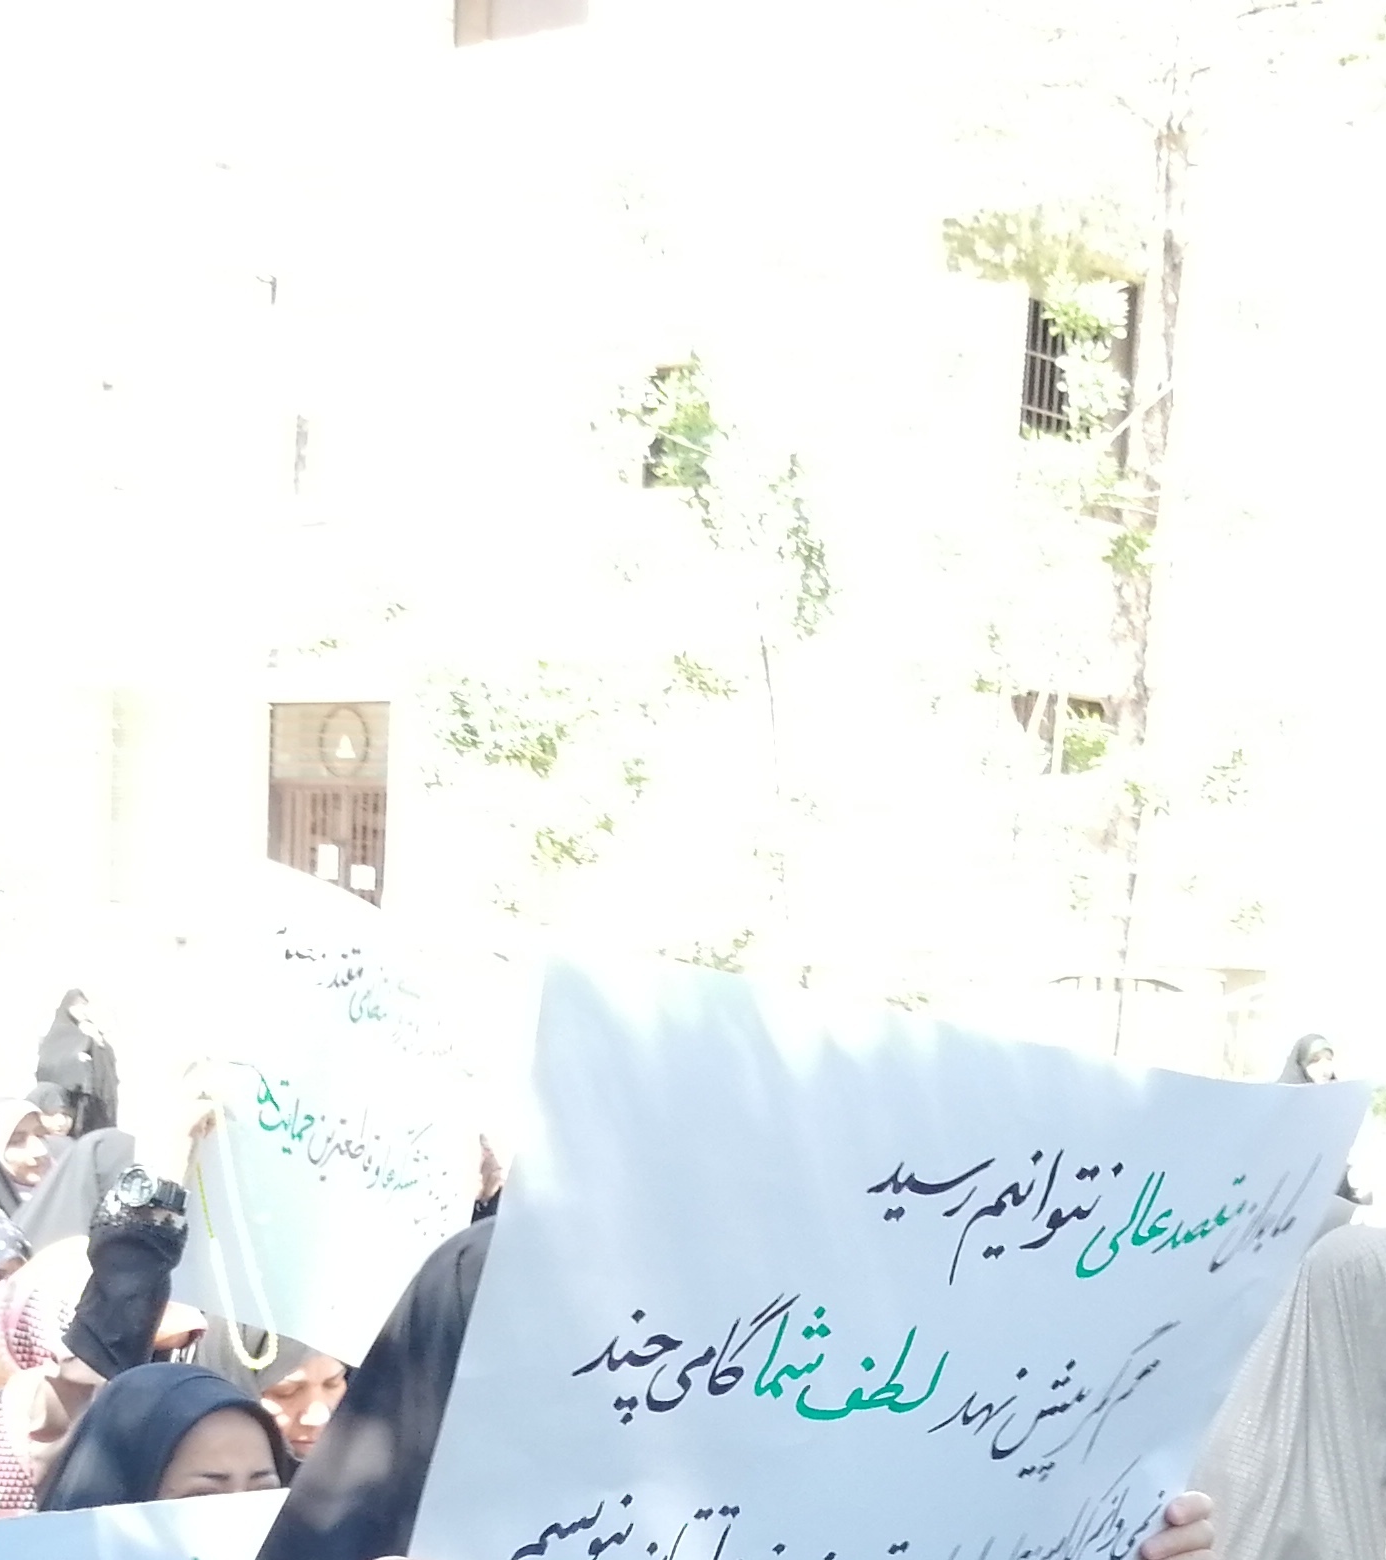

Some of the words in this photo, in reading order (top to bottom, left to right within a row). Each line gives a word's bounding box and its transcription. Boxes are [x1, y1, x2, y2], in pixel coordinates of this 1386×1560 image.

[866, 1157, 996, 1222] رسید
[948, 1148, 1124, 1286] نتوانیم
[1075, 1170, 1173, 1280] عالی
[572, 1308, 684, 1425] چند
[645, 1292, 801, 1413] گامی
[754, 1305, 831, 1399] شما
[795, 1325, 949, 1421] لطف
[927, 1367, 1029, 1437] نهد
[990, 1358, 1092, 1483] پیش
